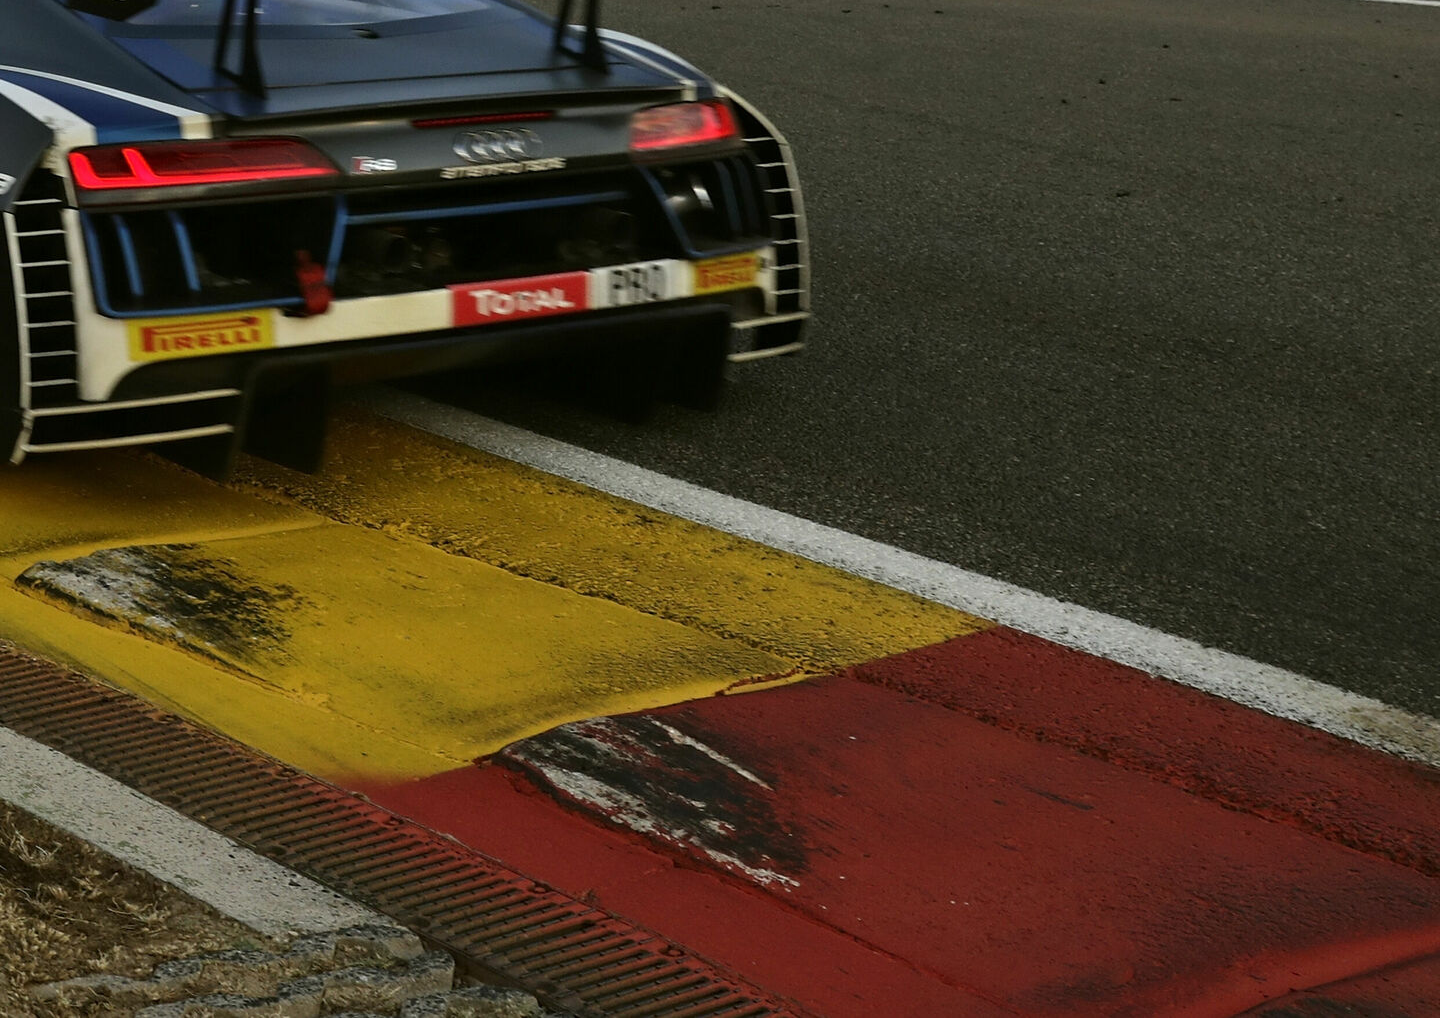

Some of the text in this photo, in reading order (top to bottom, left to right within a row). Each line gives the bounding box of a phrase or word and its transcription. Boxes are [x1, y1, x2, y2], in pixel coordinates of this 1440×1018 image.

[469, 288, 577, 317] TOTAL
[609, 263, 666, 306] PRO
[140, 316, 261, 353] PIRELLI
